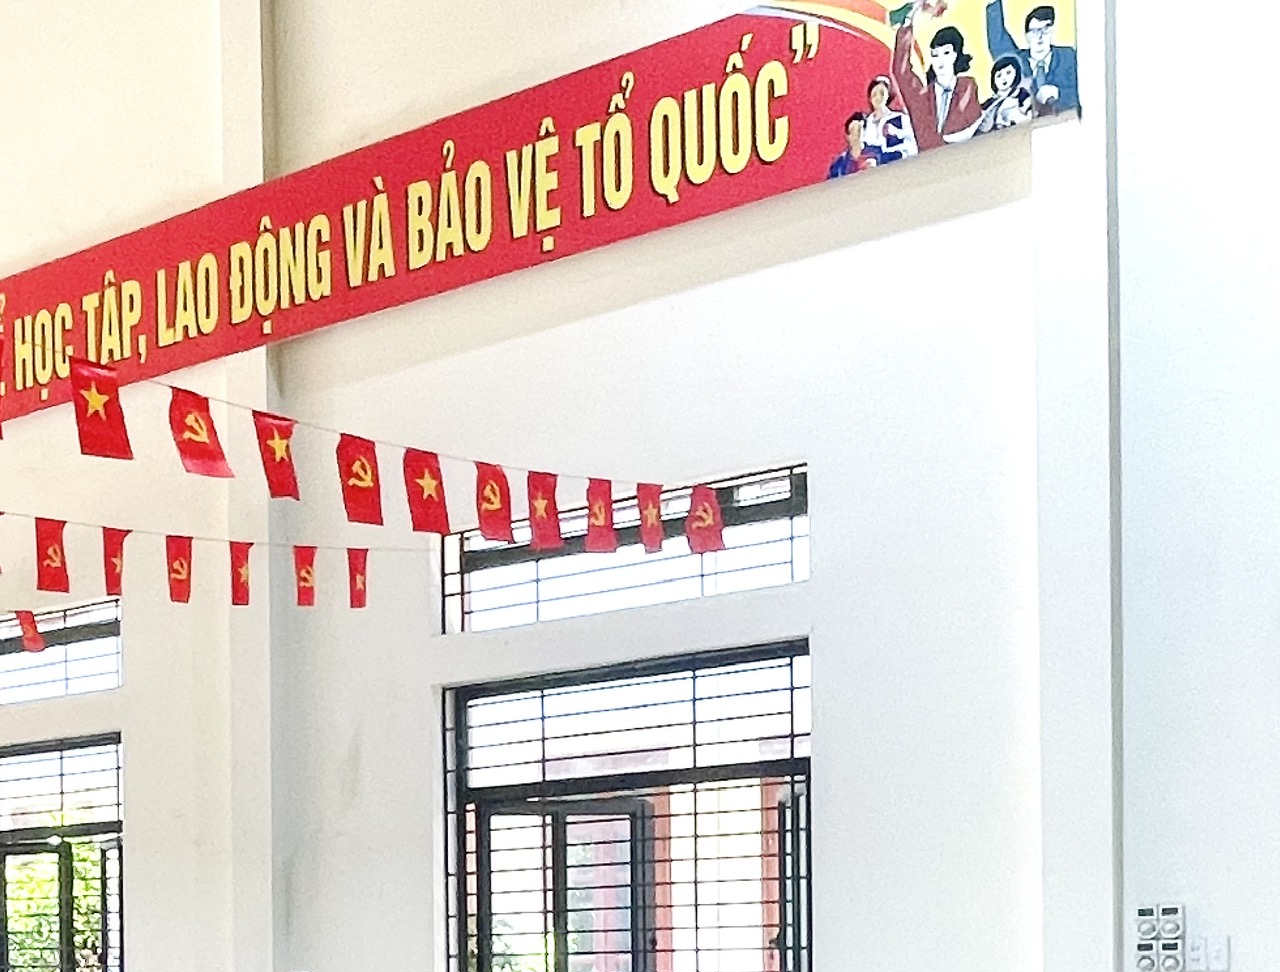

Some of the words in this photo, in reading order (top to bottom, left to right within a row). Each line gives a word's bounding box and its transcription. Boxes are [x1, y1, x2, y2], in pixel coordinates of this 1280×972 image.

[14, 302, 74, 401] HỌC
[156, 252, 219, 347] LAO
[229, 214, 332, 334] ĐỘNG
[343, 176, 396, 287] VÀ
[407, 139, 493, 270] BẢO
[506, 117, 561, 251] VỆ
[575, 72, 635, 217] TỔ
